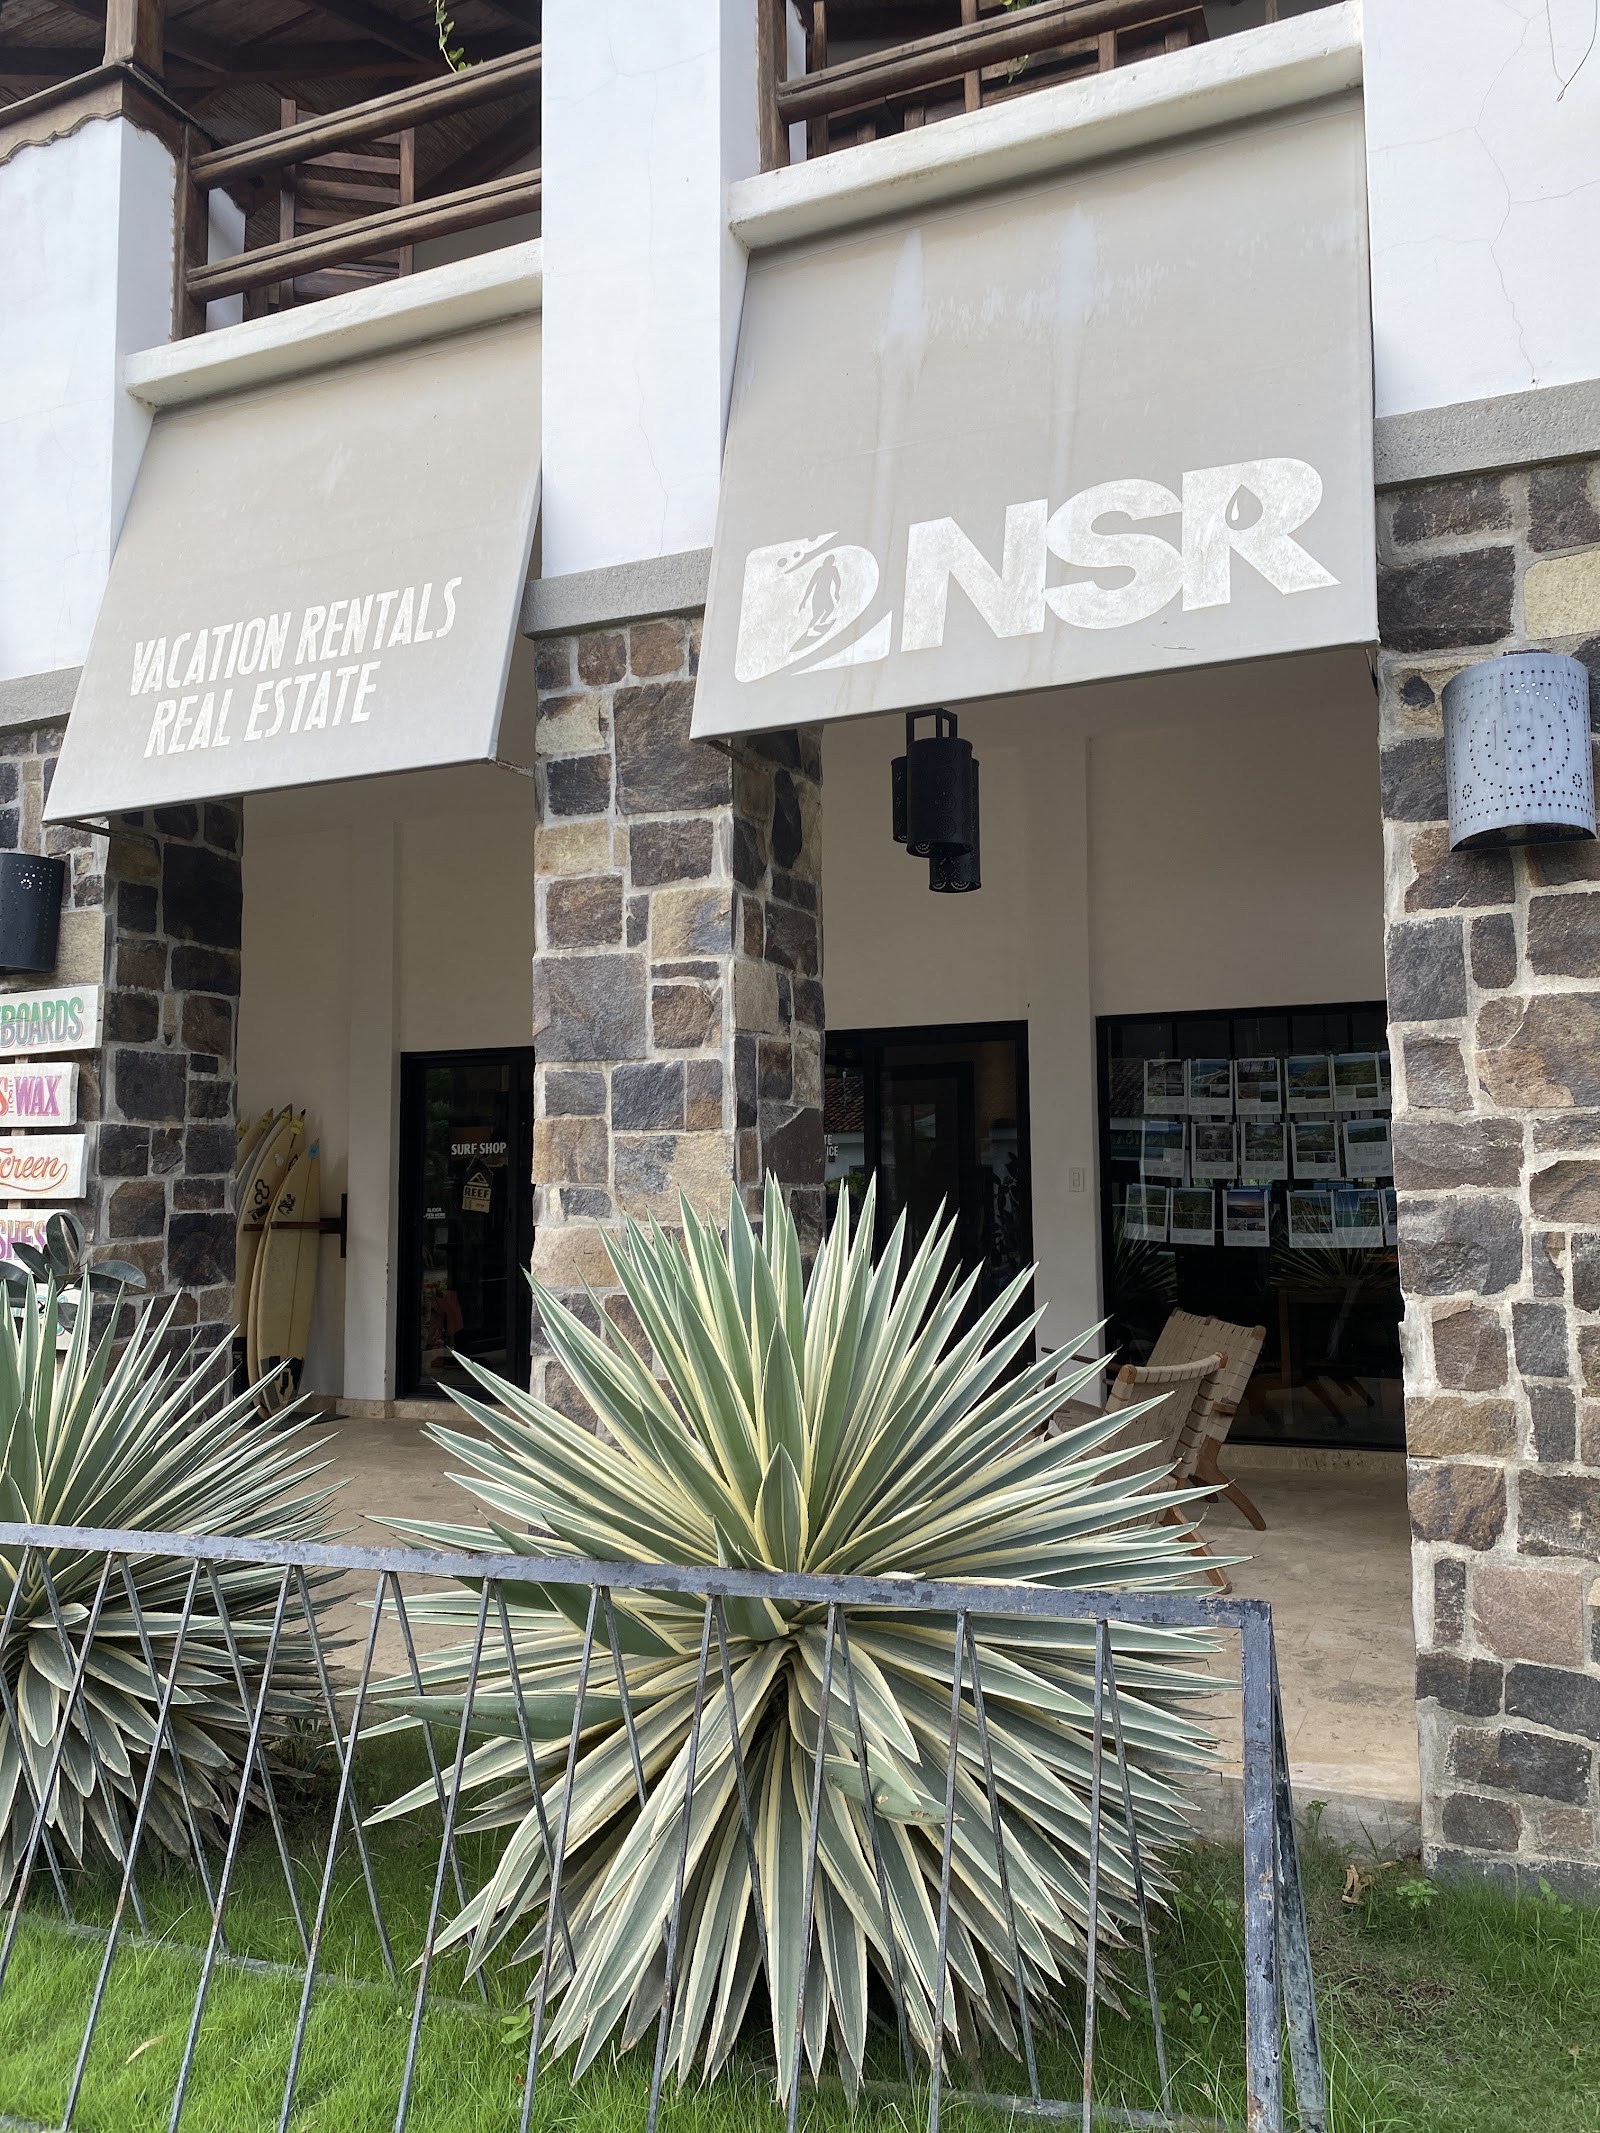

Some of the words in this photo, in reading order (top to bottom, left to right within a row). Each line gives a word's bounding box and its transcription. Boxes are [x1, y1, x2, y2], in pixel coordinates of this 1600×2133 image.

[901, 457, 1341, 652] NSR
[130, 611, 291, 696] VACATION
[294, 577, 462, 665] RENTALS
[143, 688, 233, 758] REAL
[243, 661, 381, 742] ESTATE
[0, 996, 84, 1048] BOARDS
[14, 1076, 62, 1116] WAX
[451, 1143, 478, 1156] SURF
[479, 1142, 507, 1155] SHOP
[464, 1187, 490, 1198] REEF
